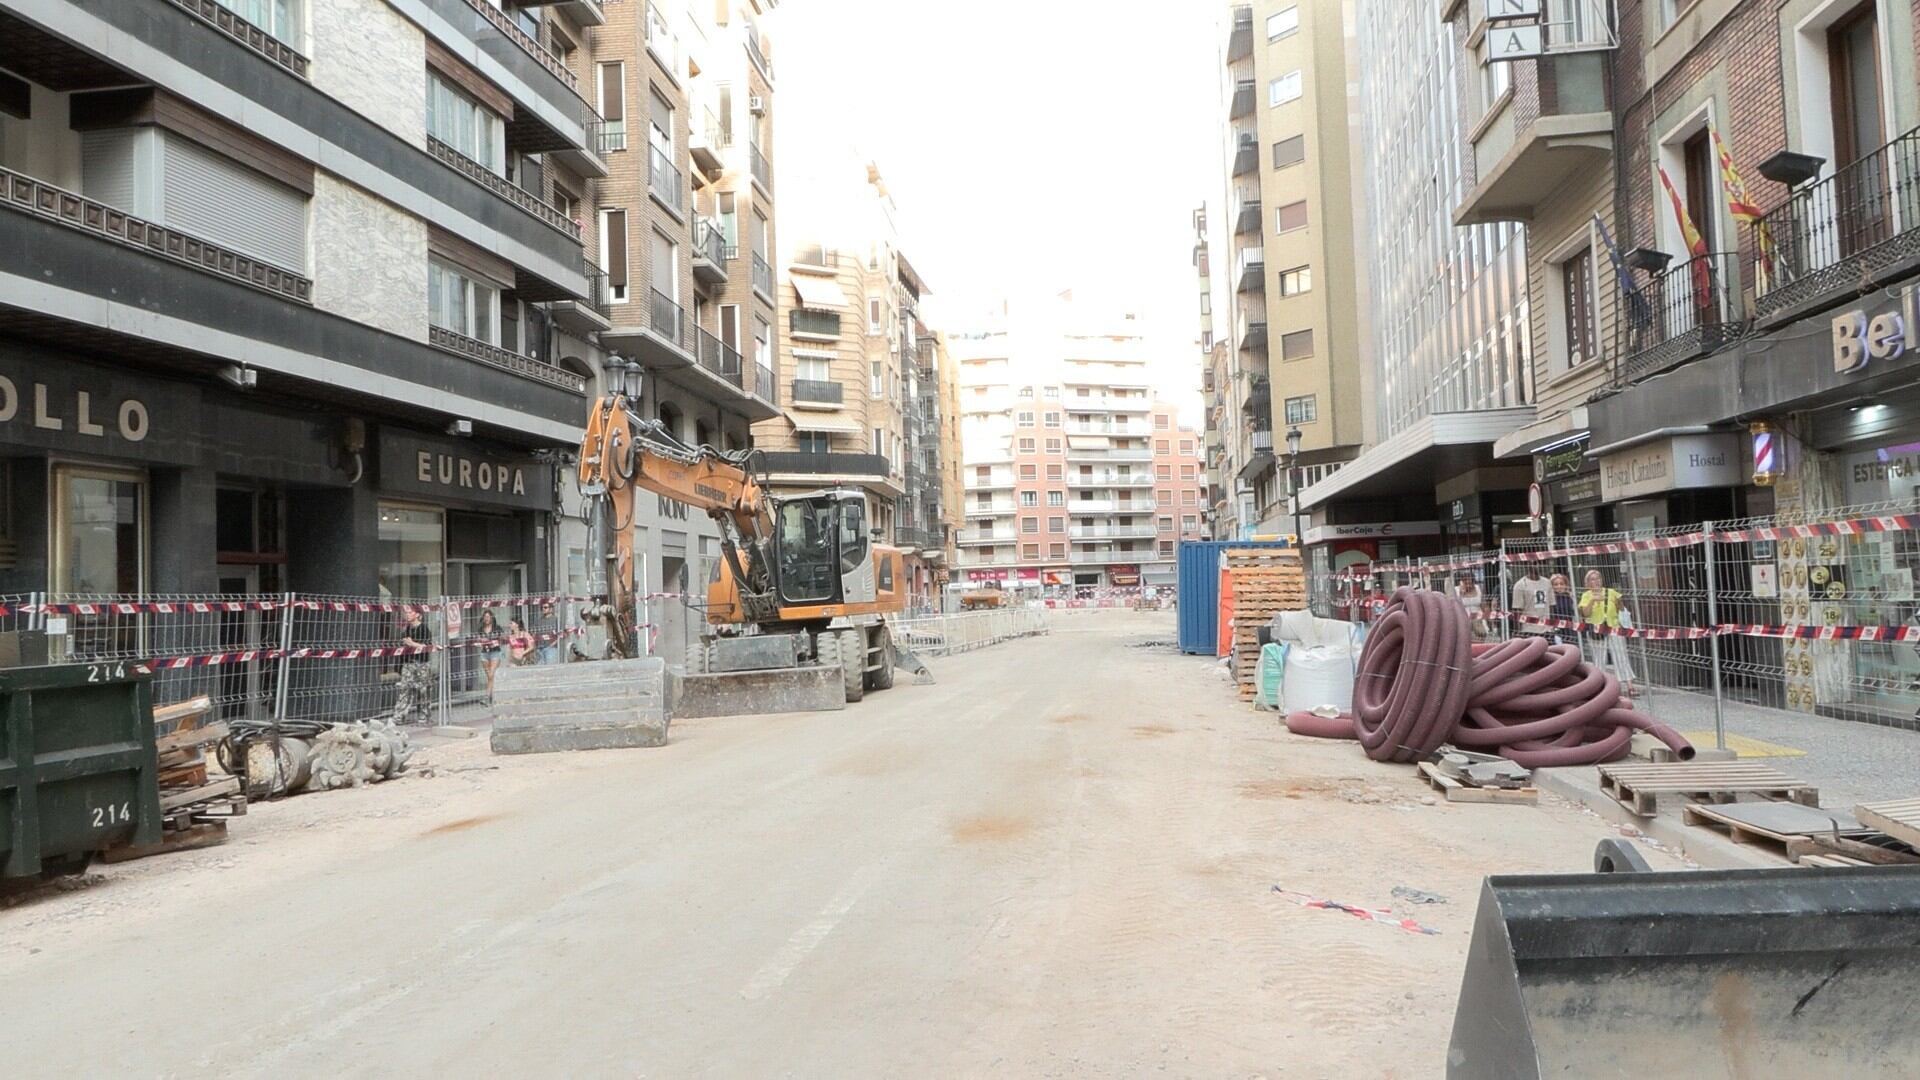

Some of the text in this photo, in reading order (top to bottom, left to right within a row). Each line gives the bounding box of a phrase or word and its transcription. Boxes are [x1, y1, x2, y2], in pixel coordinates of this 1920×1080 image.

[418, 451, 525, 496] EUROPA
[1688, 452, 1726, 468] Hostal
[1606, 461, 1631, 489] Hostal
[87, 661, 125, 682] 214
[92, 801, 130, 828] 214
